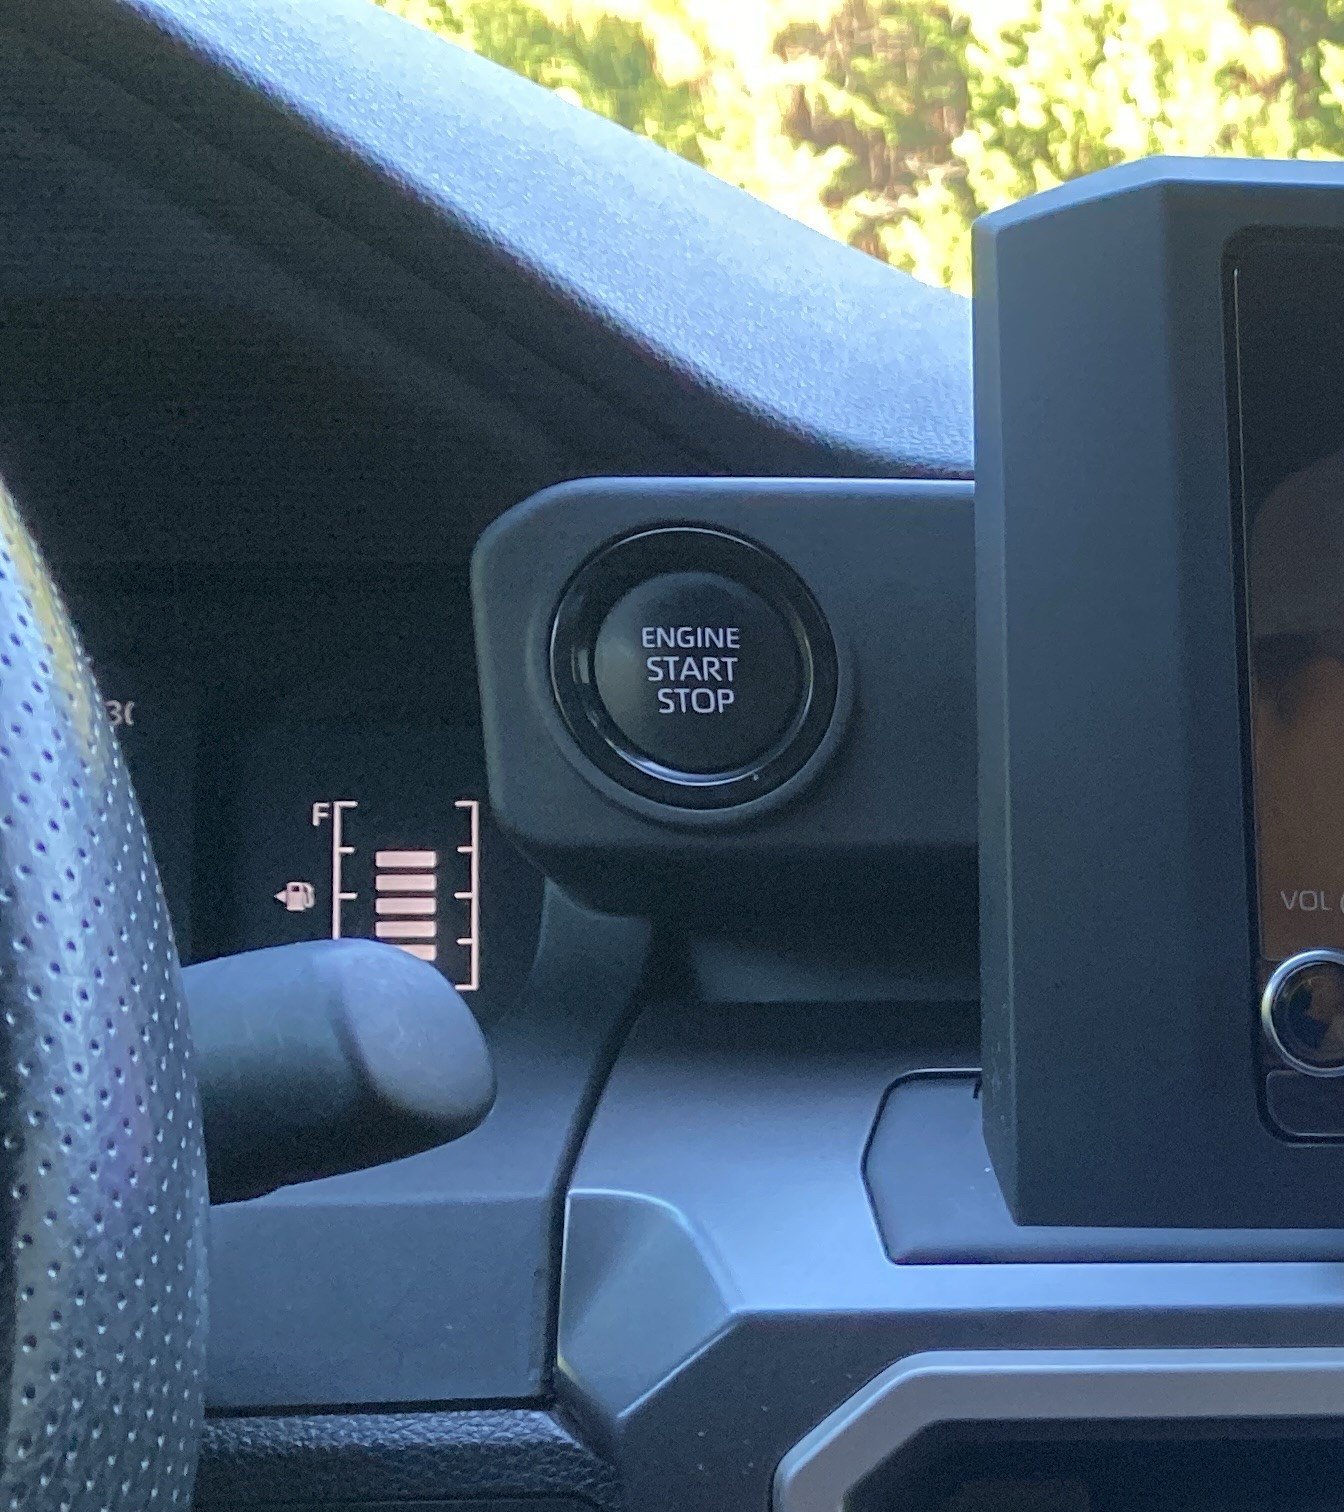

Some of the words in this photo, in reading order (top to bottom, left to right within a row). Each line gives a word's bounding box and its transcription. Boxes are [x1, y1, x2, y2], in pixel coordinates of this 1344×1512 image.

[641, 626, 741, 649] ENGINE
[646, 655, 739, 682] START
[657, 687, 736, 714] STOP
[312, 802, 329, 827] F
[1280, 889, 1333, 912] VOL
